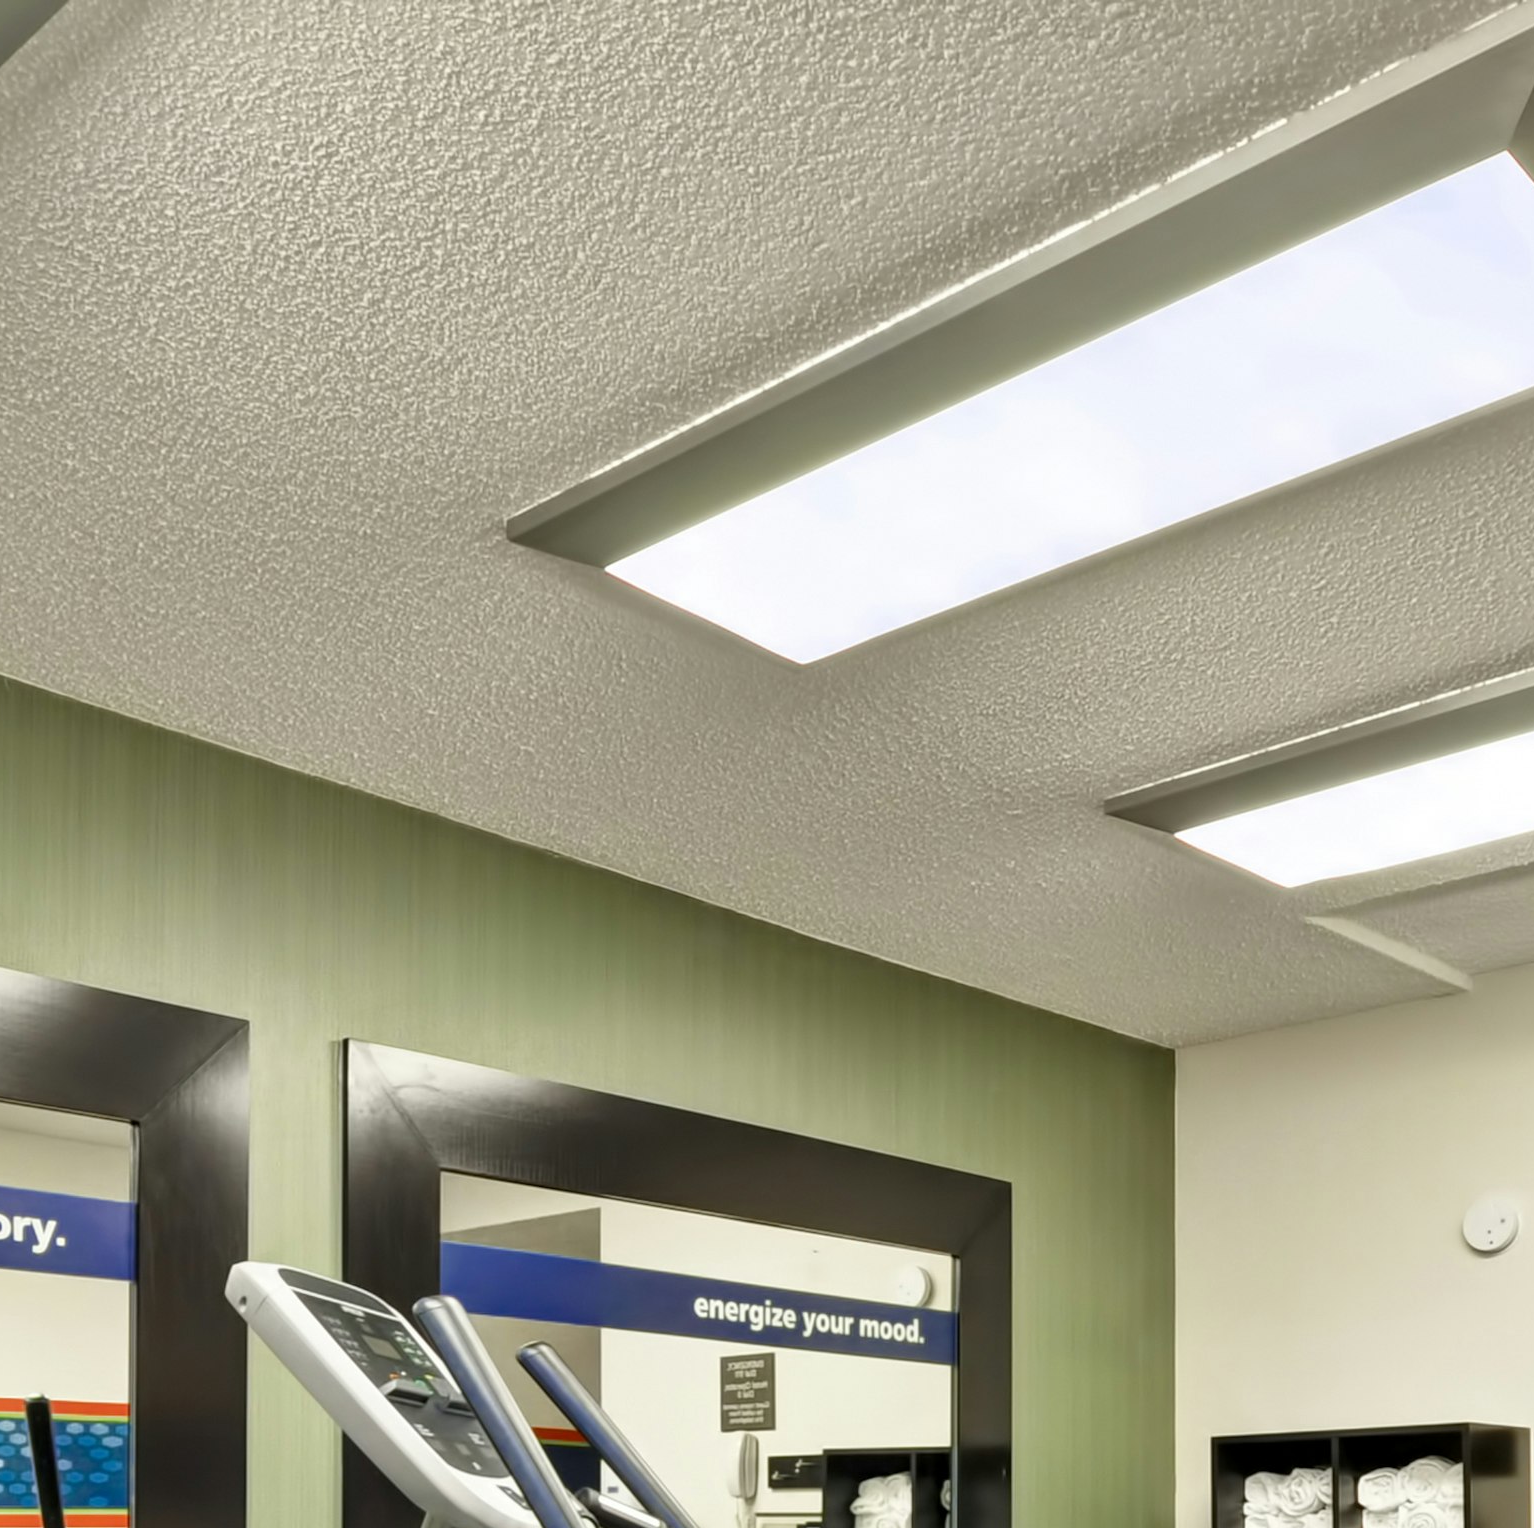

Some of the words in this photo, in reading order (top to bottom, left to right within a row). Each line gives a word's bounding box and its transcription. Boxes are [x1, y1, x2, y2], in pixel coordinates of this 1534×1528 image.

[693, 1297, 797, 1331] energize
[802, 1311, 854, 1337] your
[859, 1318, 925, 1344] mood.
